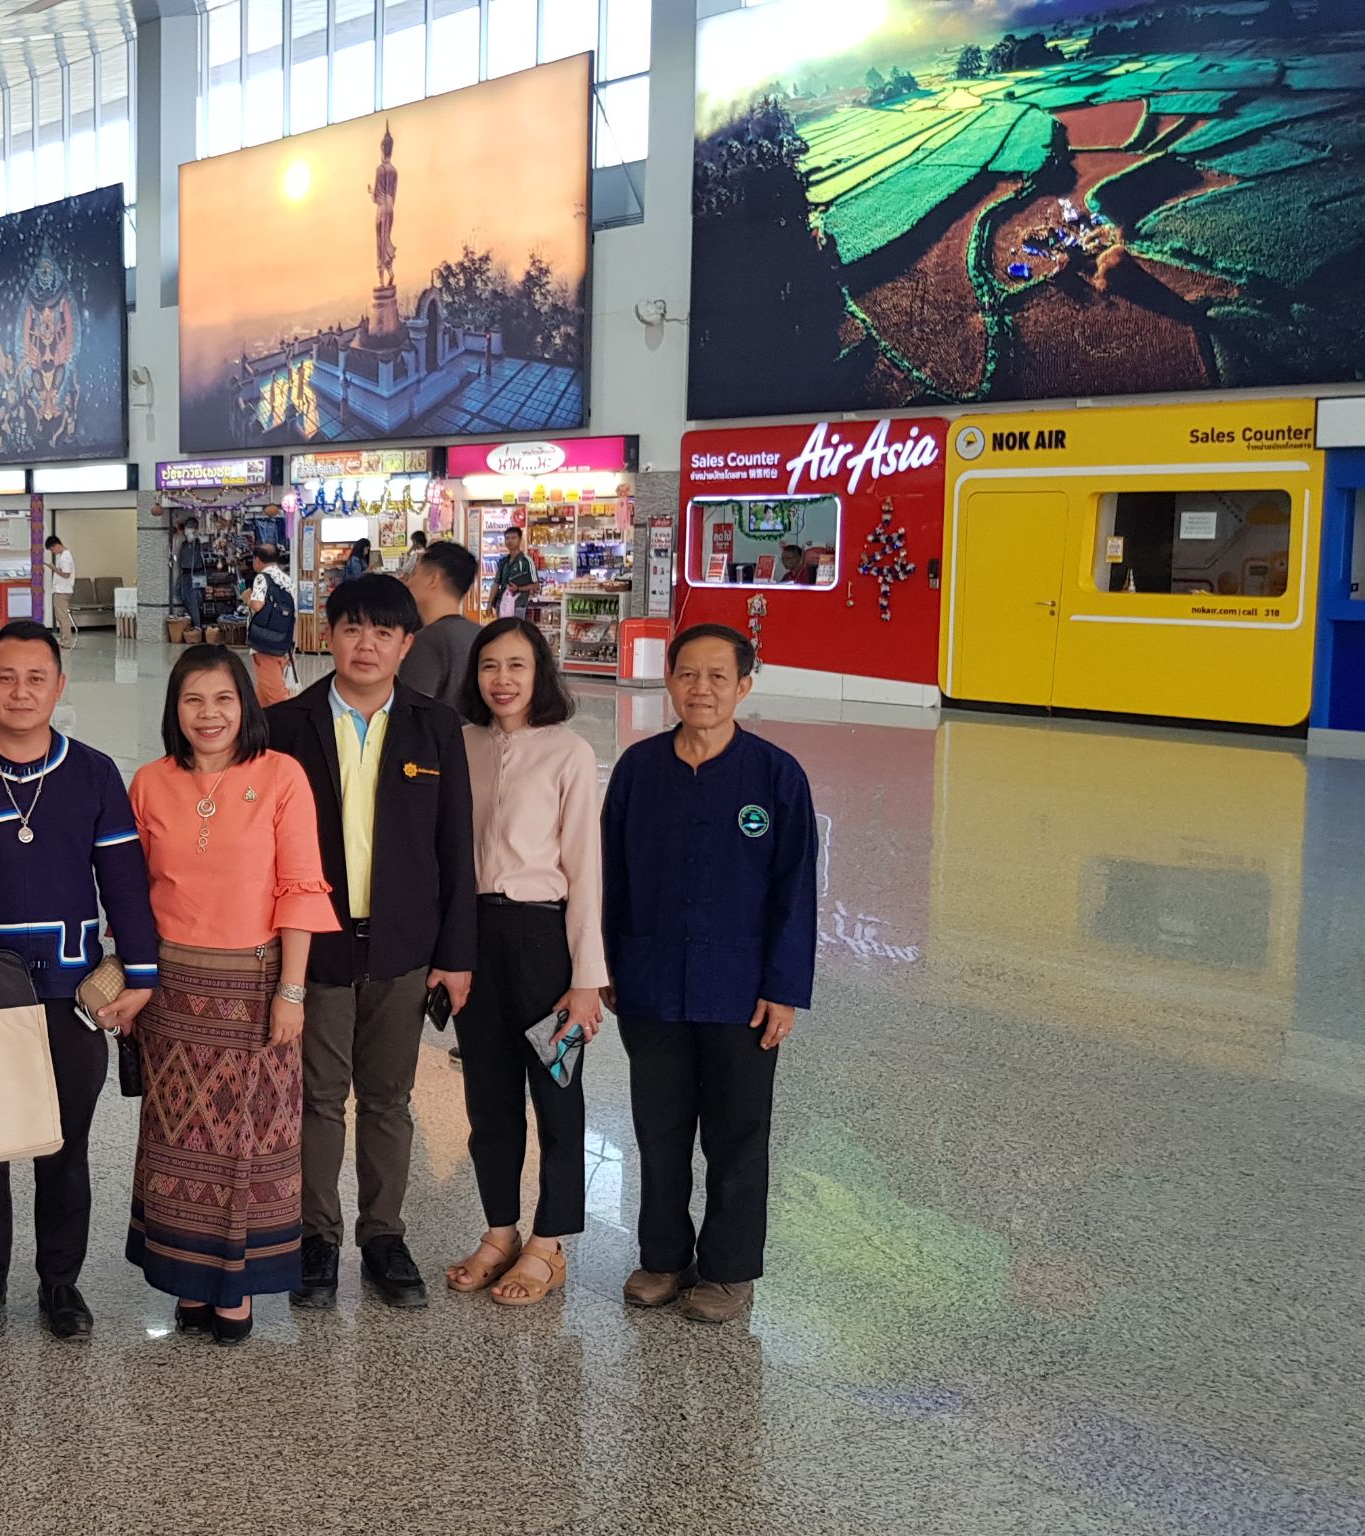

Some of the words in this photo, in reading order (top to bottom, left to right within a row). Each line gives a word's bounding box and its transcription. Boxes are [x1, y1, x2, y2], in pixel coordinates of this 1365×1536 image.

[992, 431, 1031, 452] NOK
[1035, 429, 1067, 450] AIR
[1189, 427, 1235, 444] Sales
[1242, 425, 1312, 442] Counter
[691, 453, 724, 468] Sales
[727, 451, 780, 466] Counter
